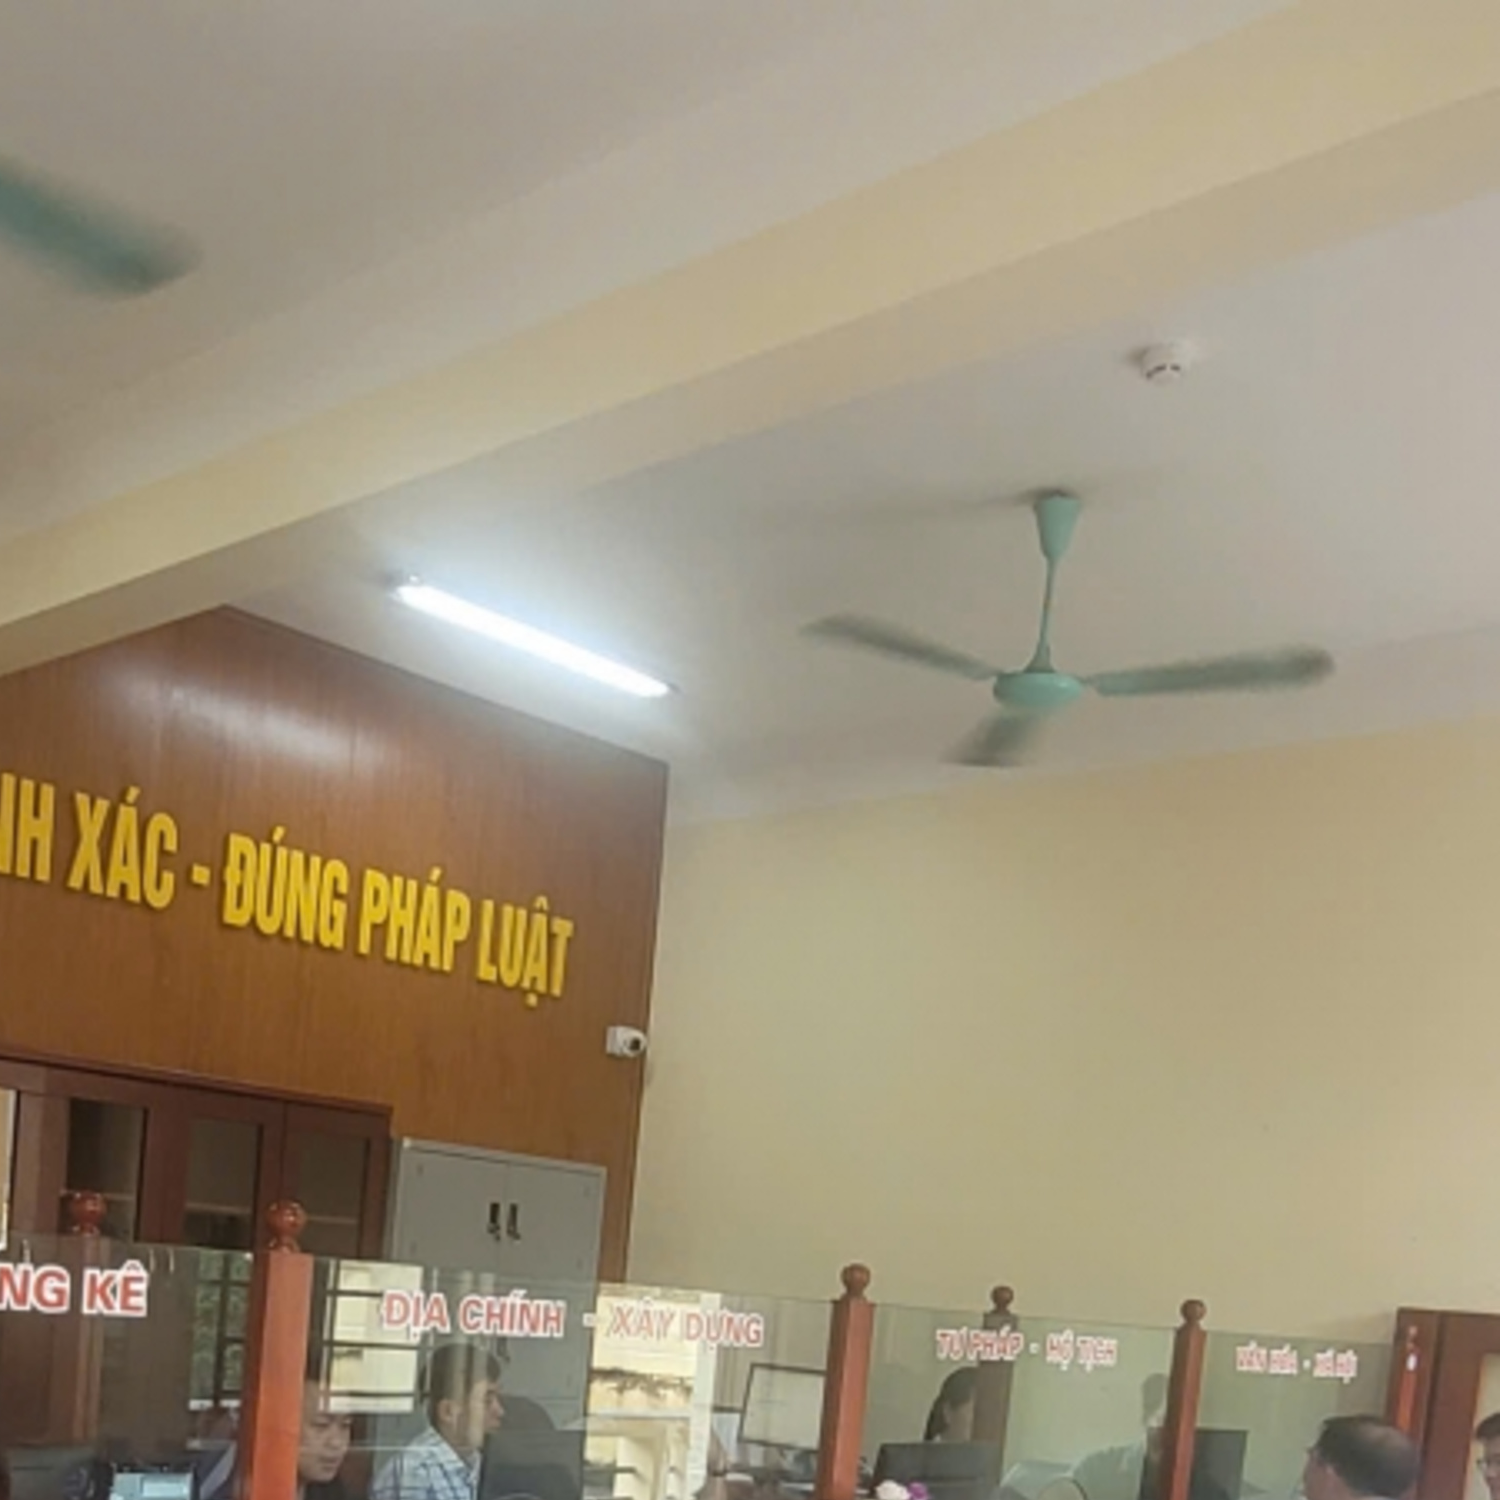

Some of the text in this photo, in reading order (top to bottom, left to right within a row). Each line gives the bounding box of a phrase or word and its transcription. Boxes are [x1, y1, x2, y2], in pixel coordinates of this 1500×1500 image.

[67, 786, 179, 911] XÁC
[221, 825, 349, 951] ĐÚNG
[357, 866, 472, 973] PHÁP
[475, 895, 575, 1008] LUẬT
[81, 1259, 148, 1317] KÊ
[382, 1289, 451, 1342] ĐỊA
[458, 1289, 565, 1338] CHÍNH
[606, 1298, 677, 1338] XÂY
[681, 1307, 765, 1352] DỰNG
